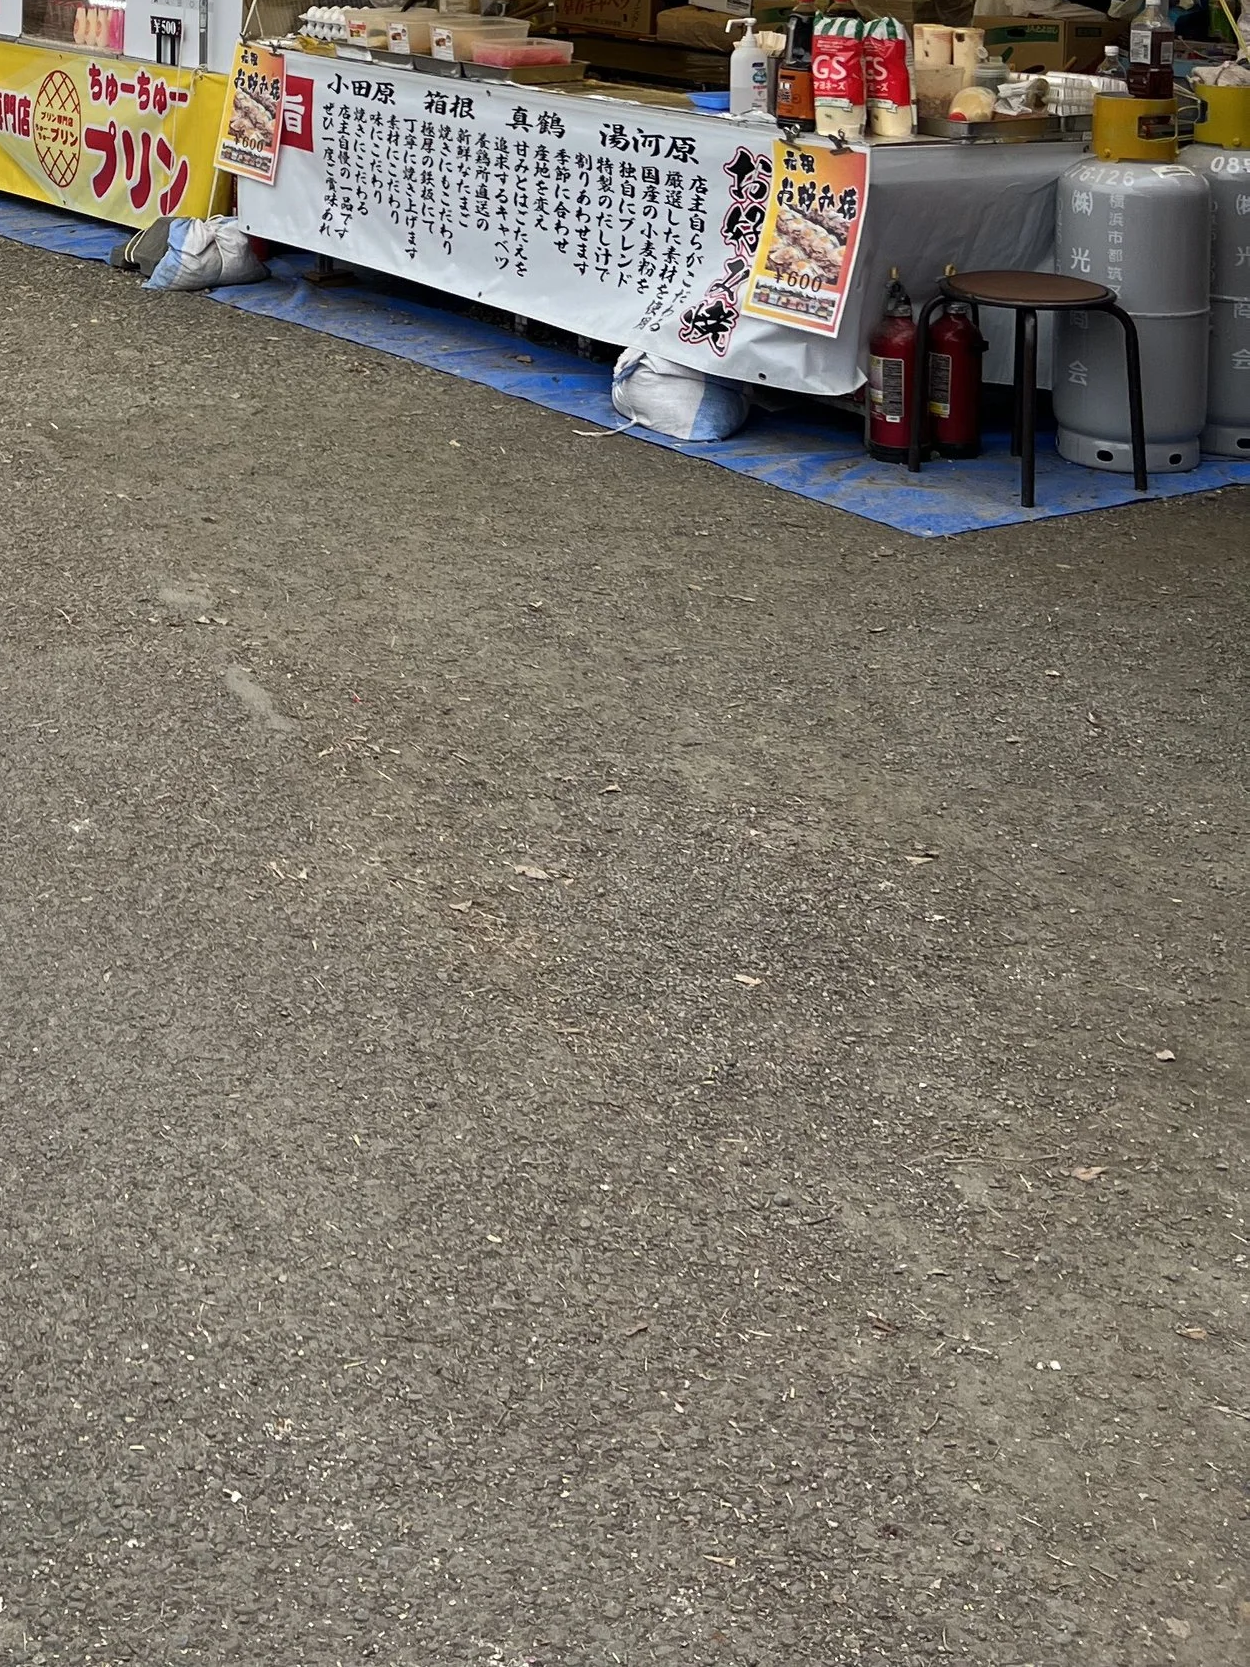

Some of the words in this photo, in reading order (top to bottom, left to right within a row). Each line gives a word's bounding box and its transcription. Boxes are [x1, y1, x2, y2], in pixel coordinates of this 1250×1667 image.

[153, 19, 176, 35] ¥500
[812, 55, 847, 80] GS
[51, 128, 78, 147] プリン
[89, 62, 188, 116] ちゅーちゅー
[327, 73, 396, 105] 小田原
[424, 91, 475, 119] 箱根
[506, 106, 566, 139] 真鶴
[599, 123, 699, 164] 湯河原
[85, 121, 188, 216] プリン
[319, 102, 338, 237] ぜひ一度ご賞味あれ
[335, 105, 353, 239] 店主自慢の一品です
[353, 107, 368, 216] 焼きにこだわる
[370, 111, 383, 204] 味にこだわり
[387, 114, 400, 224] 素材にこだわり
[402, 119, 418, 259] 丁寧に焼き上げます
[420, 121, 435, 234] 極厚の鉄板にて
[438, 124, 453, 255] 焼きにもこだわり
[475, 132, 490, 231] 養鶏所直送の
[494, 137, 510, 270] 追求するキャベツ
[533, 145, 550, 231] 産地を変え
[554, 149, 571, 254] 季節に合わせ
[573, 153, 592, 275] 割りあわせます
[594, 157, 615, 283] 特製のだし汁で
[618, 161, 638, 288] 独自にブレンド
[636, 166, 661, 294] 国産の小麦粉を
[774, 268, 823, 293] ¥600
